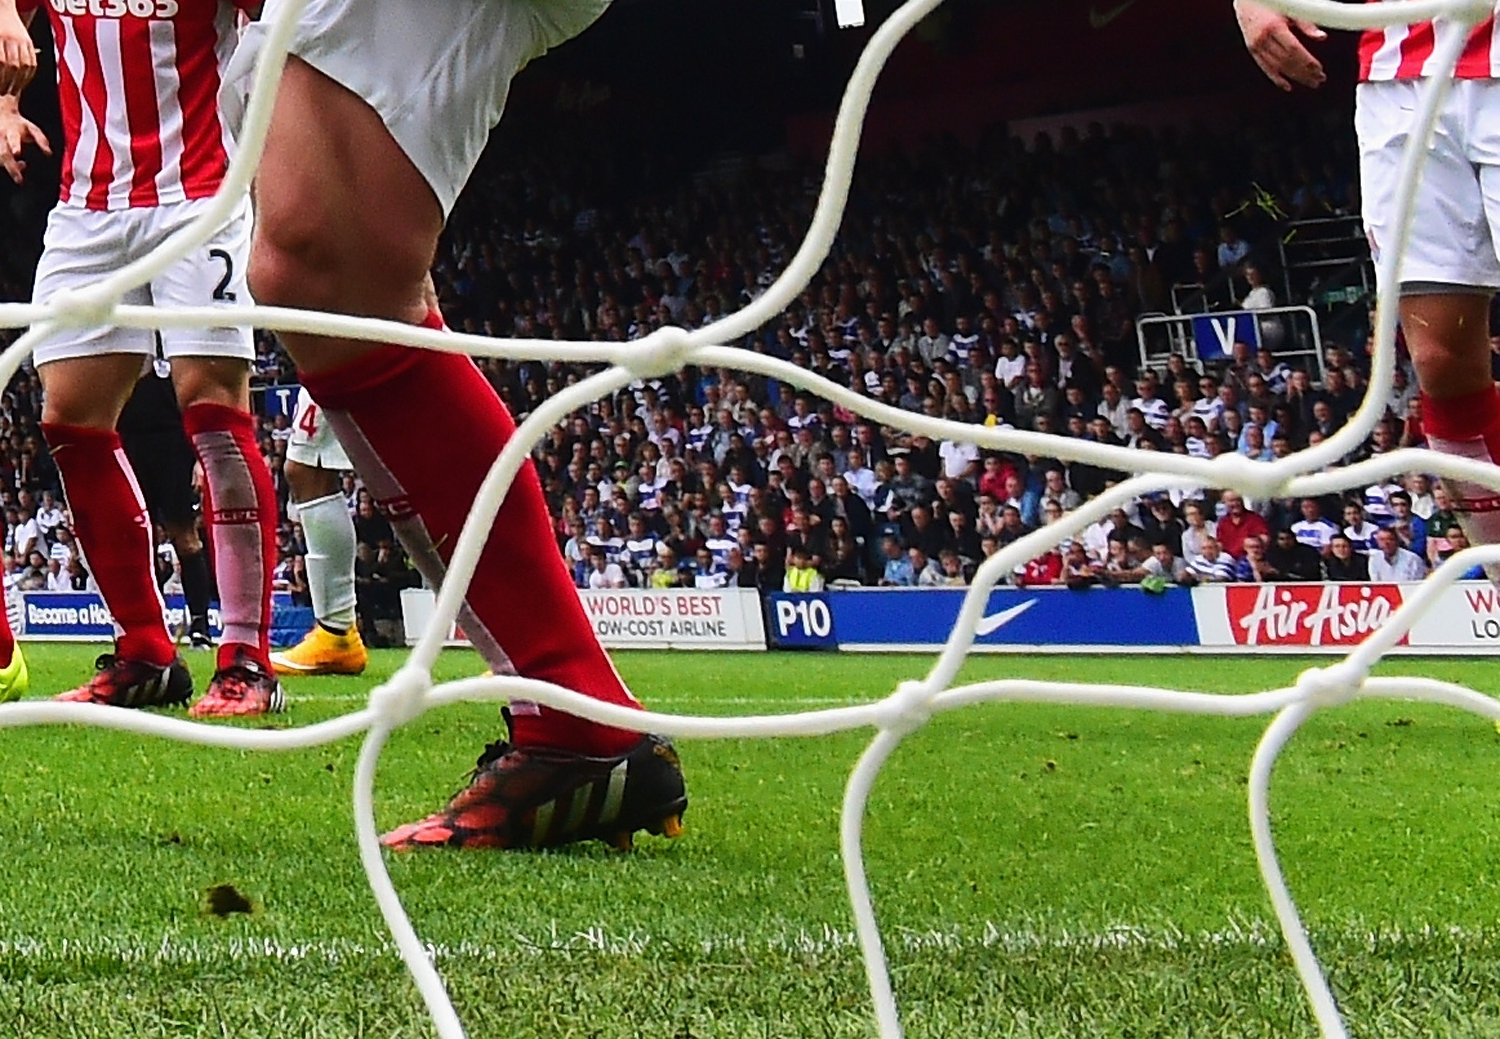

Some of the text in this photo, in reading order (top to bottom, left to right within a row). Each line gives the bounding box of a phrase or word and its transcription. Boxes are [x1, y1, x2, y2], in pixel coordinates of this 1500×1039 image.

[208, 248, 237, 301] 2
[1210, 317, 1236, 356] V
[299, 403, 319, 438] 4
[28, 603, 77, 625] Become
[587, 596, 722, 615] WORLD'S BEST
[776, 599, 831, 637] P10
[595, 620, 727, 636] OW-COST AIRLINE
